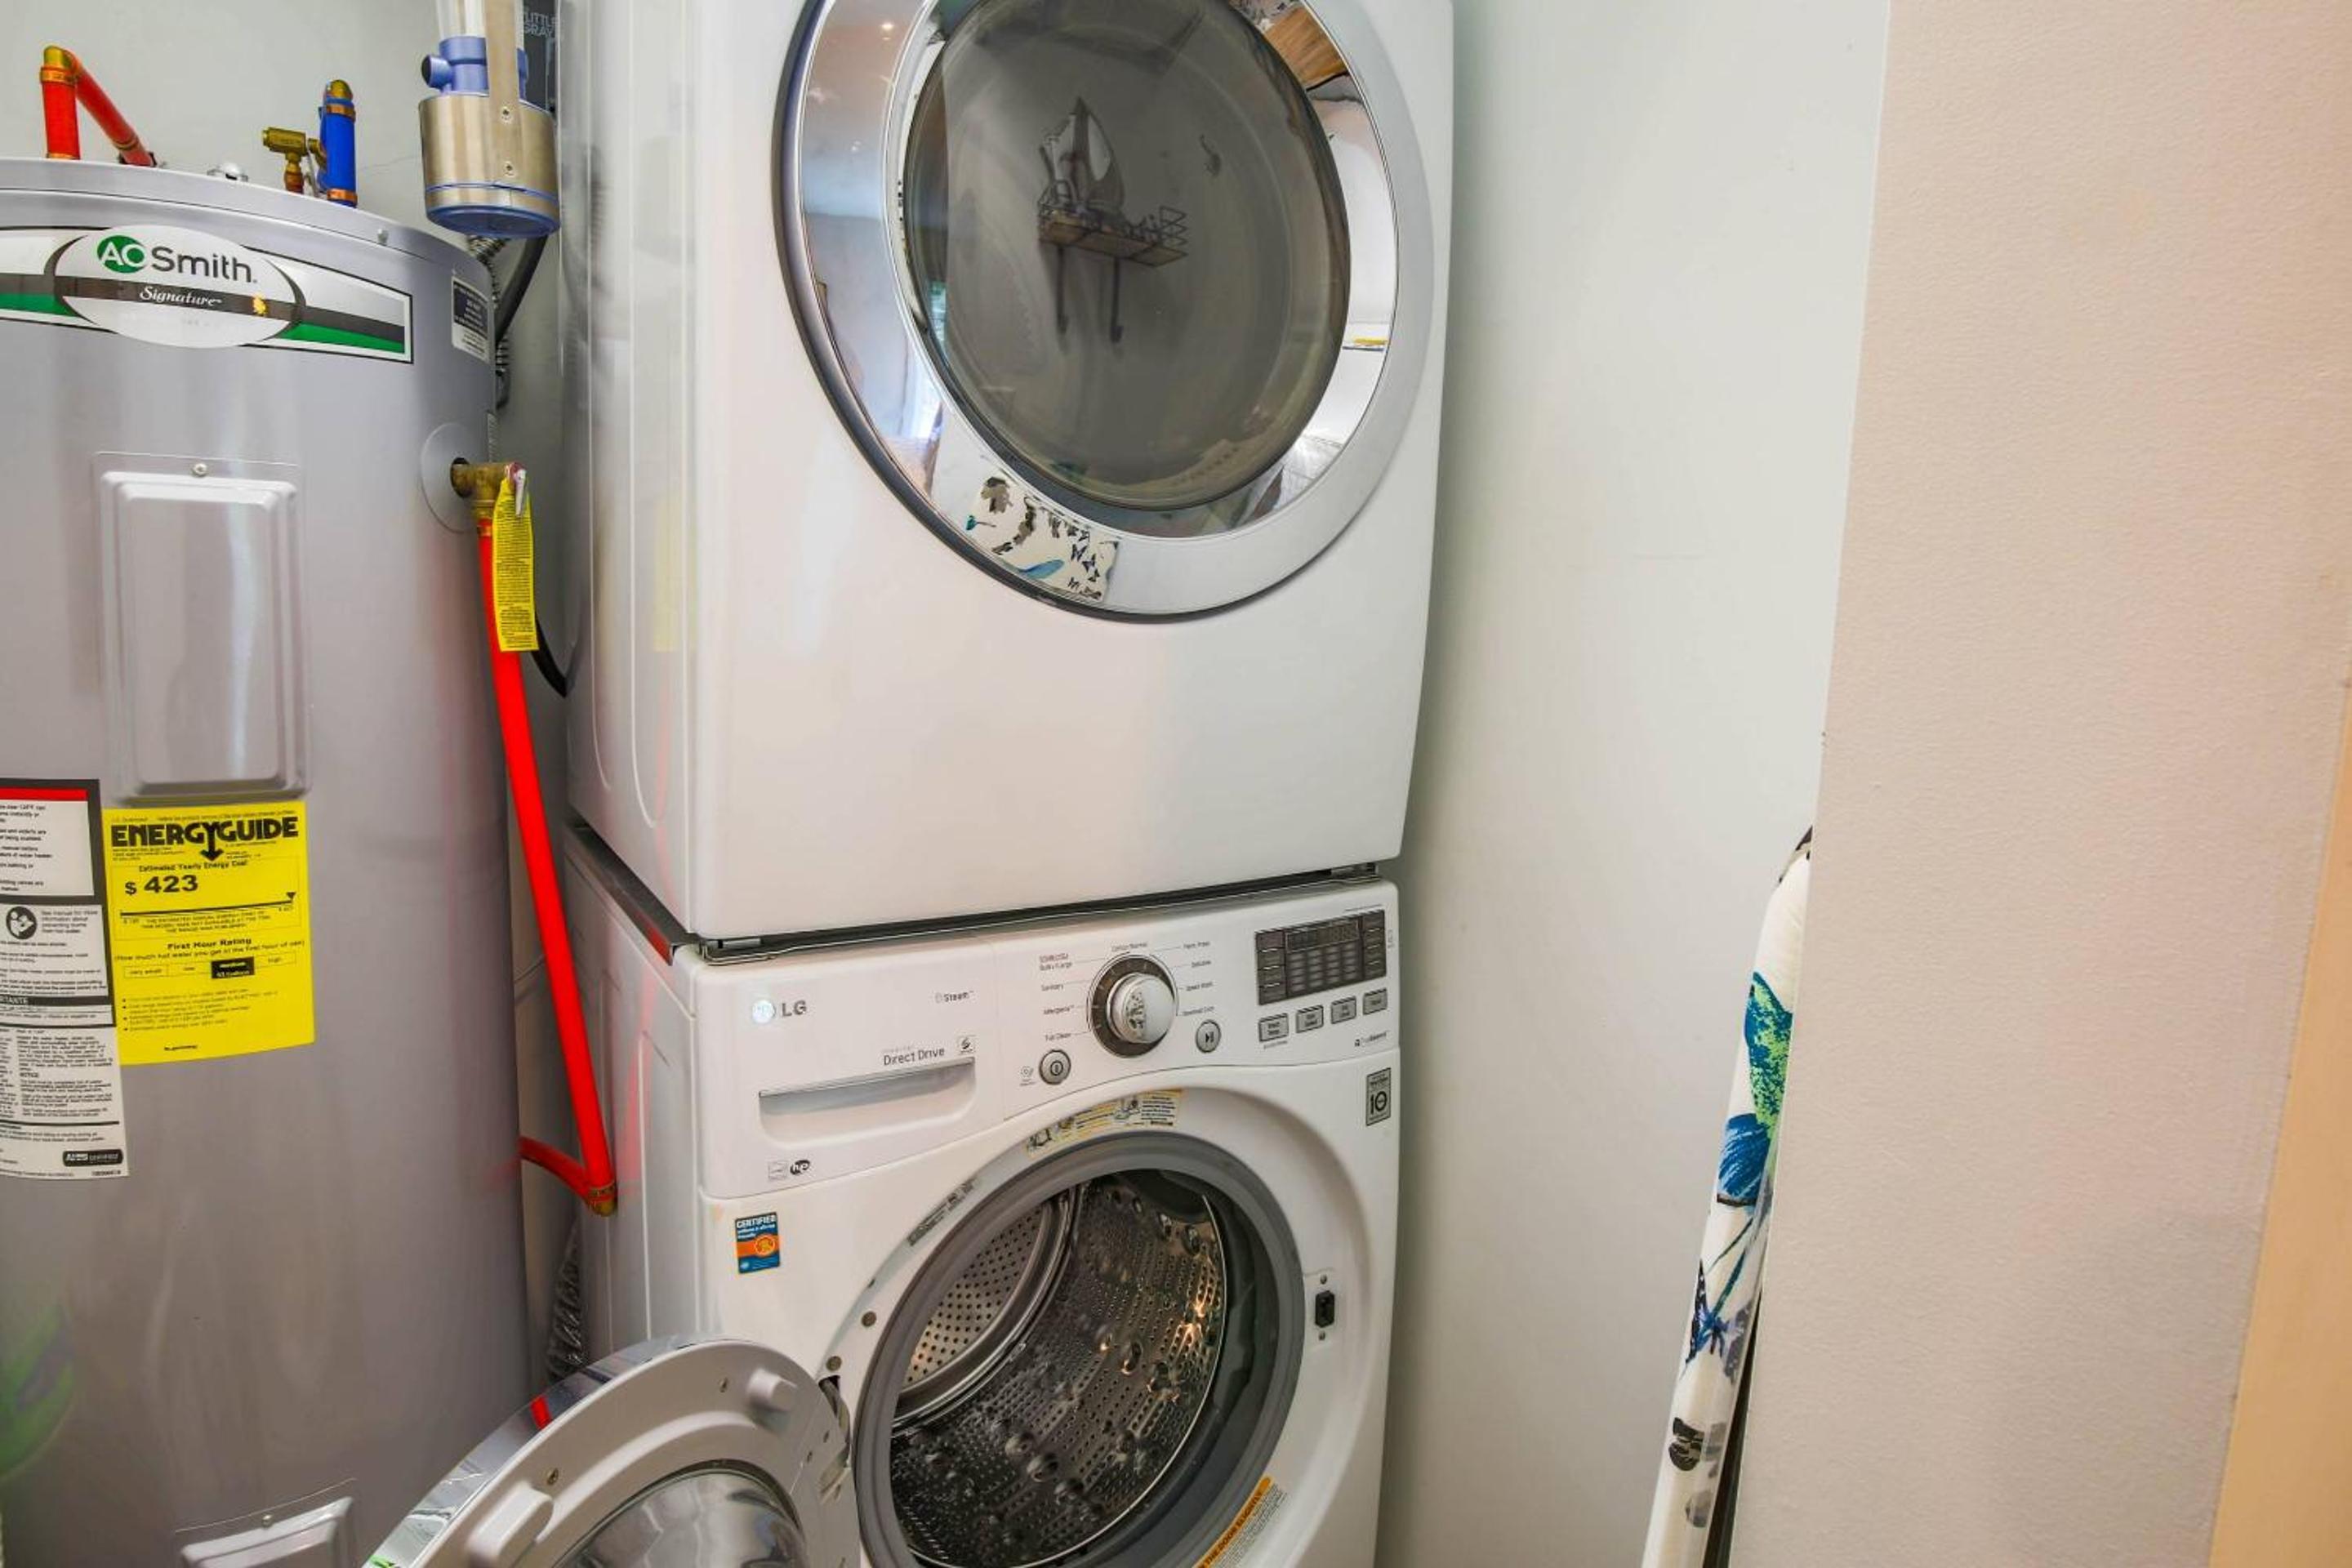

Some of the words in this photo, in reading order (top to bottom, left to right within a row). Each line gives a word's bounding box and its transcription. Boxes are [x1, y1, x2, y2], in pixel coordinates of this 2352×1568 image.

[100, 240, 148, 269] AO
[152, 247, 252, 283] Smith
[139, 285, 221, 307] Signature
[111, 817, 299, 848] ENERGYGUIDE
[125, 881, 137, 896] $
[144, 874, 198, 893] 423
[167, 942, 190, 951] First
[782, 1000, 807, 1017] LG
[884, 1052, 916, 1066] Direct
[918, 1047, 945, 1061] Drive
[1370, 1090, 1388, 1116] 10
